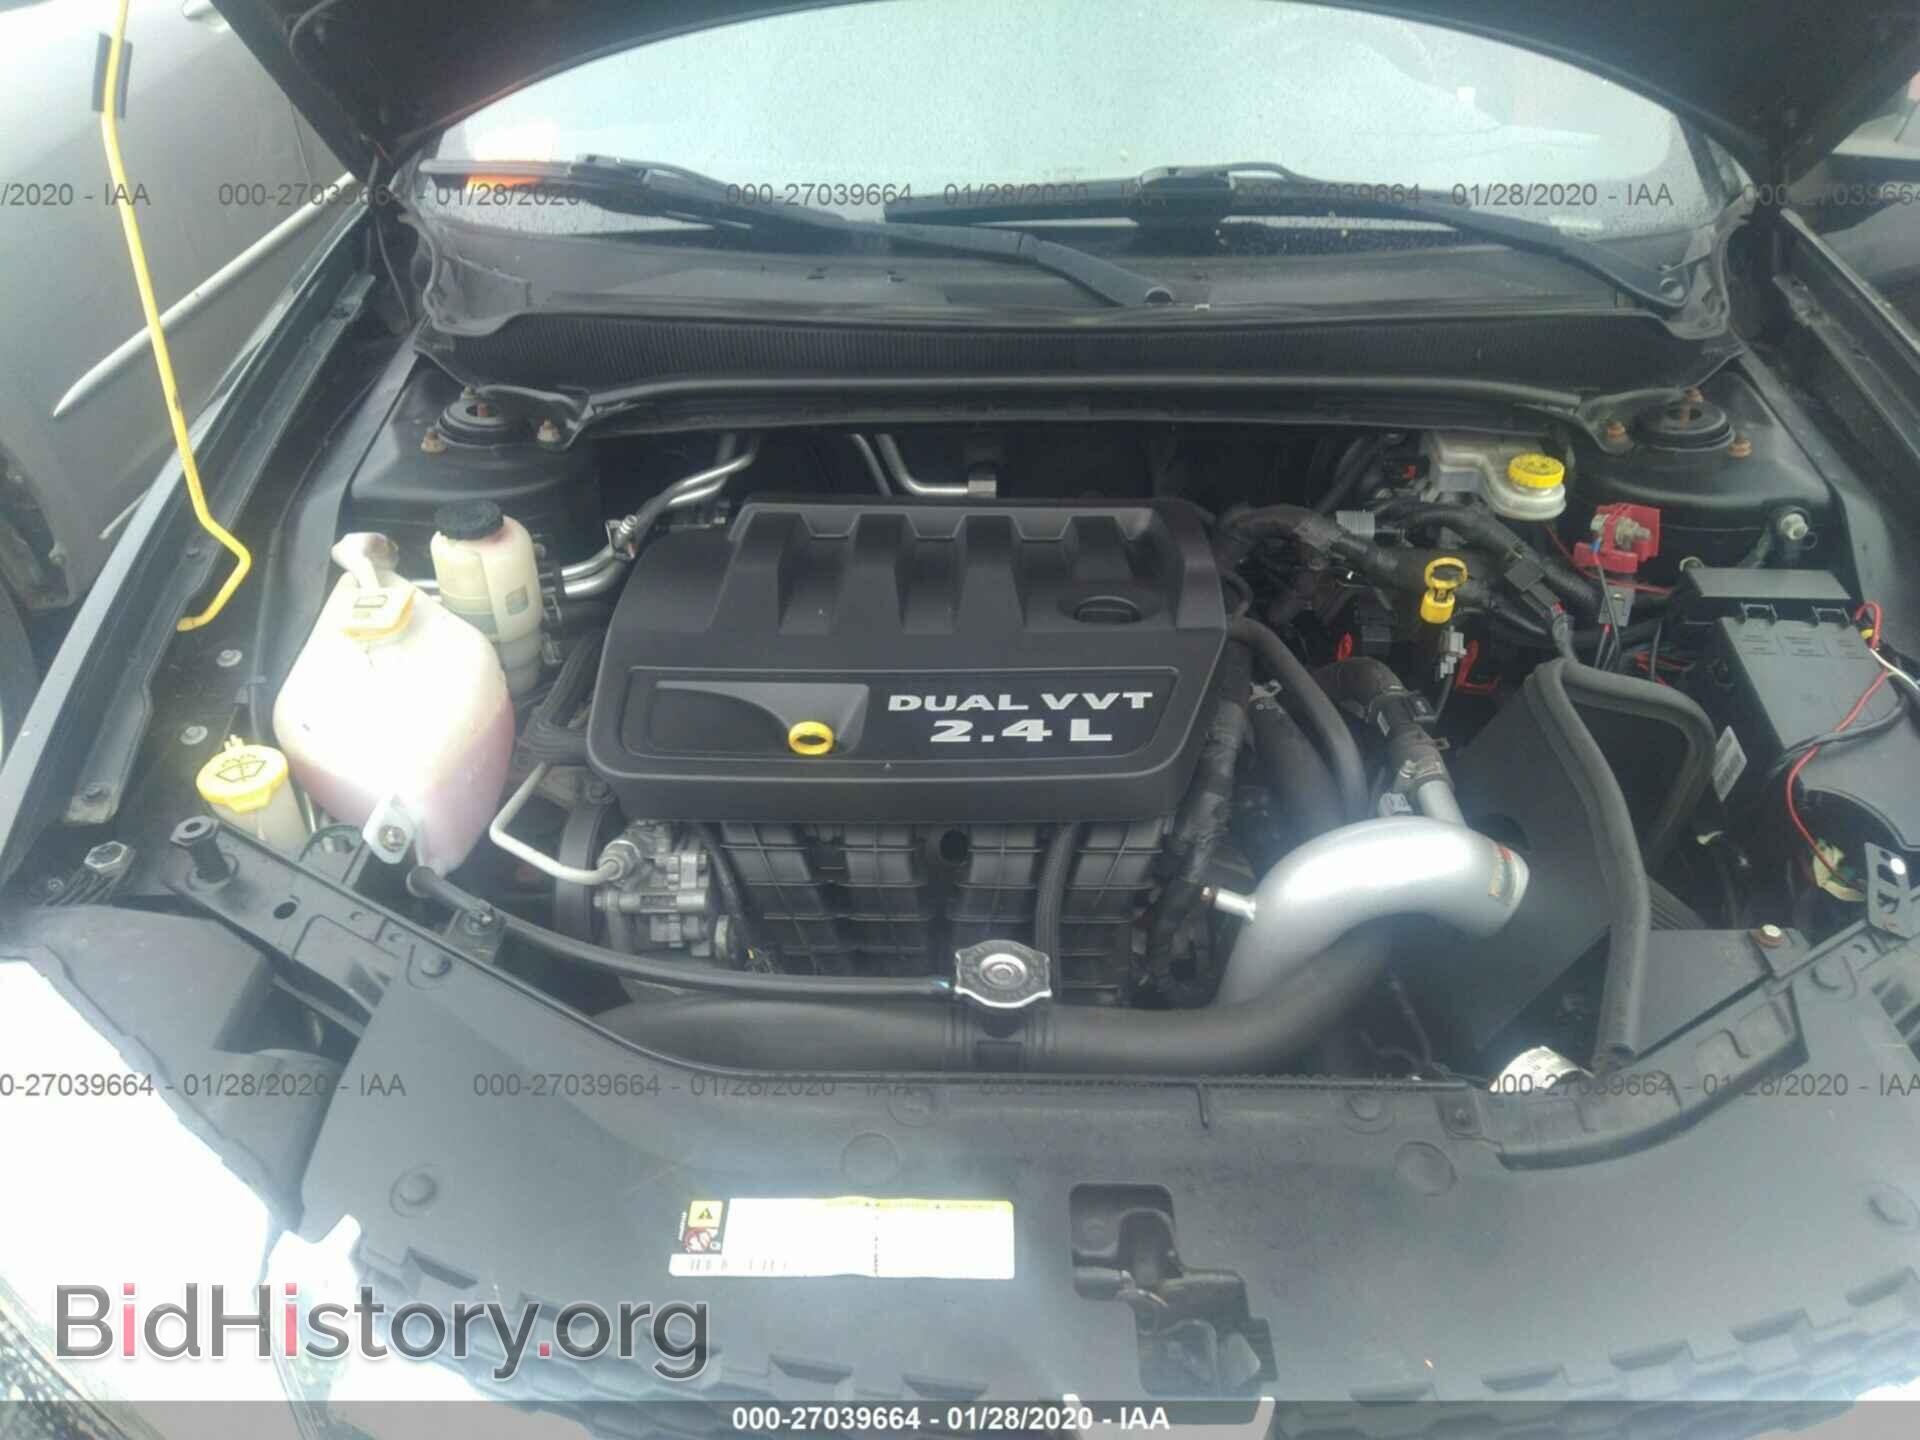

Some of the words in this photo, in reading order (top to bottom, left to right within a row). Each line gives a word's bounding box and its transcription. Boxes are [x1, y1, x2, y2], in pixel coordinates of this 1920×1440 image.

[887, 693, 1029, 712] DUAL
[1040, 691, 1153, 711] VVT
[929, 719, 1053, 743] 2.4
[1070, 718, 1112, 742] L
